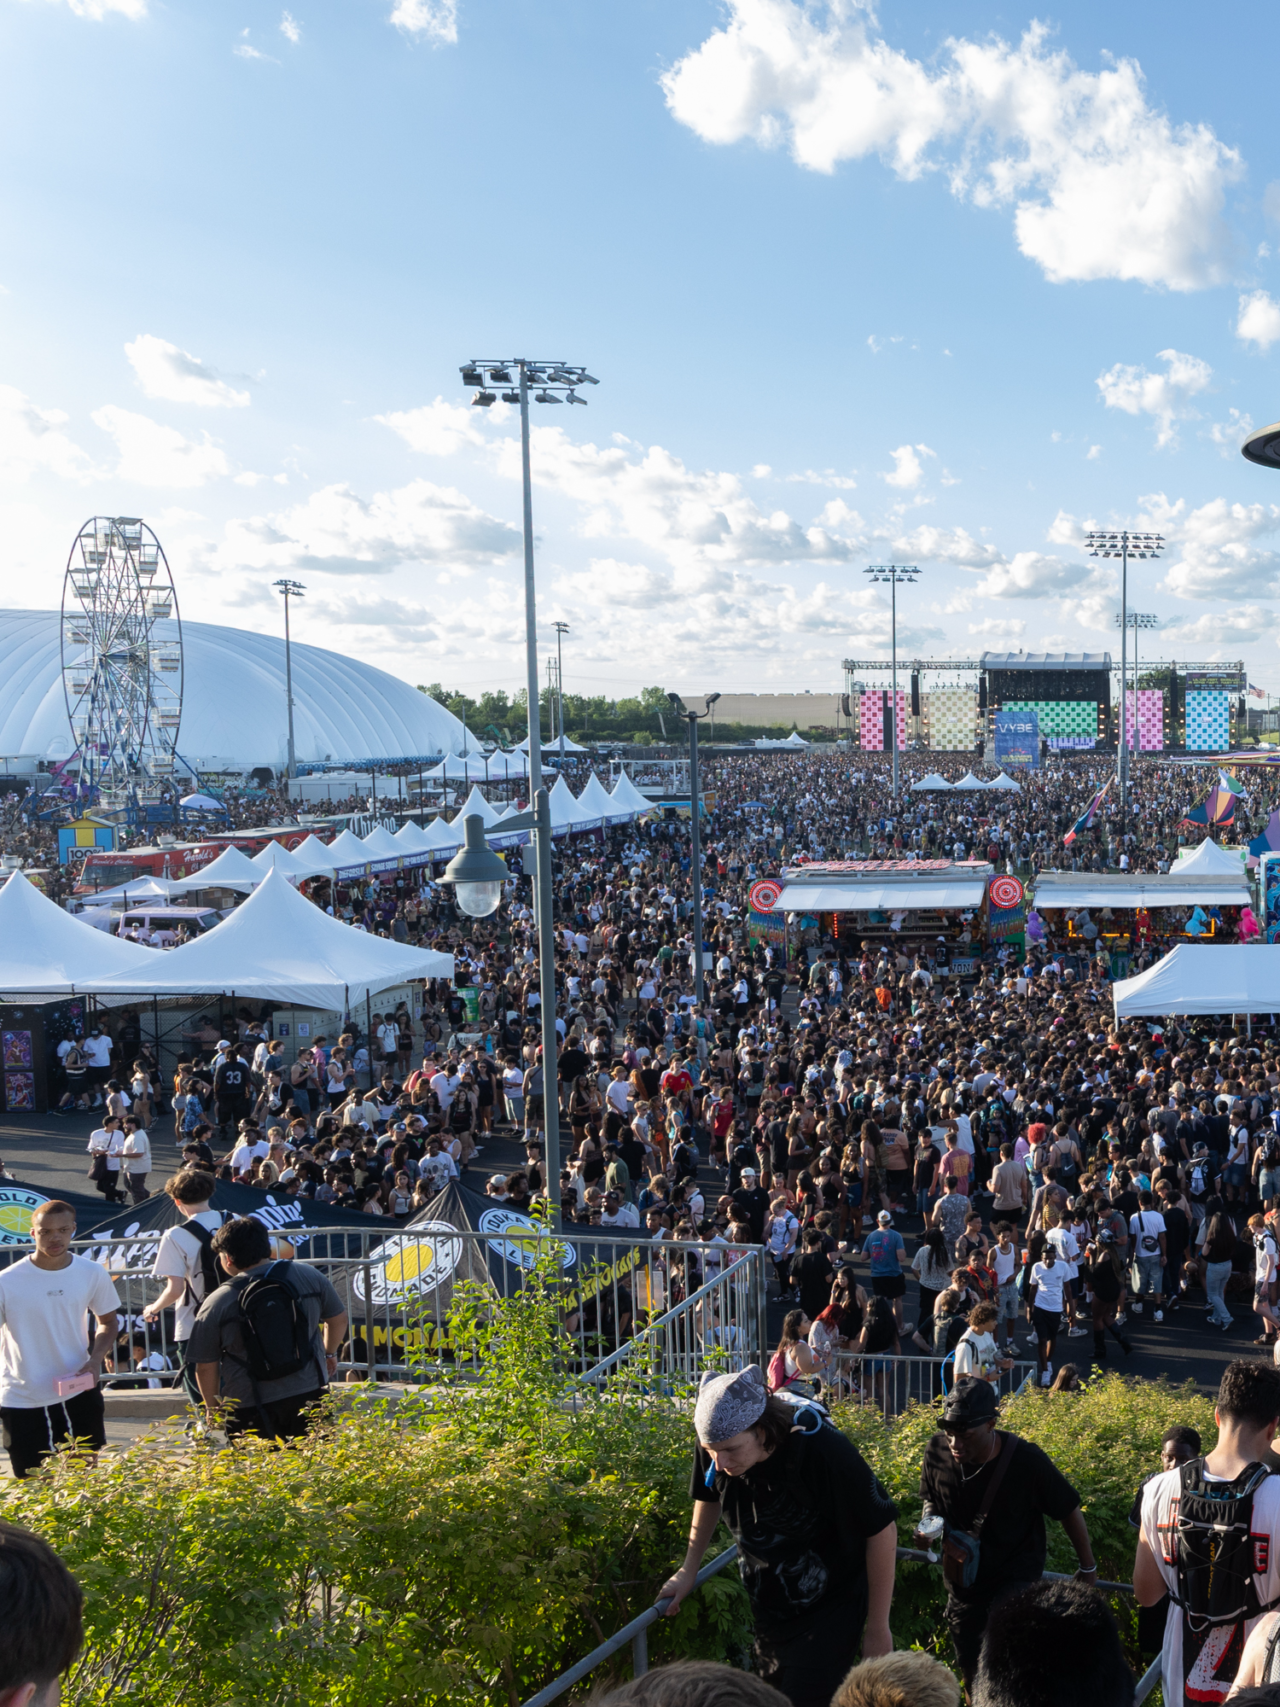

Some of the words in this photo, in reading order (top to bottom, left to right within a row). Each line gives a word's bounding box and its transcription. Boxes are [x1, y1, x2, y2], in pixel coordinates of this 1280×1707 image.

[998, 723, 1033, 733] VYBE
[183, 848, 214, 863] Harold's
[226, 1071, 241, 1083] 33
